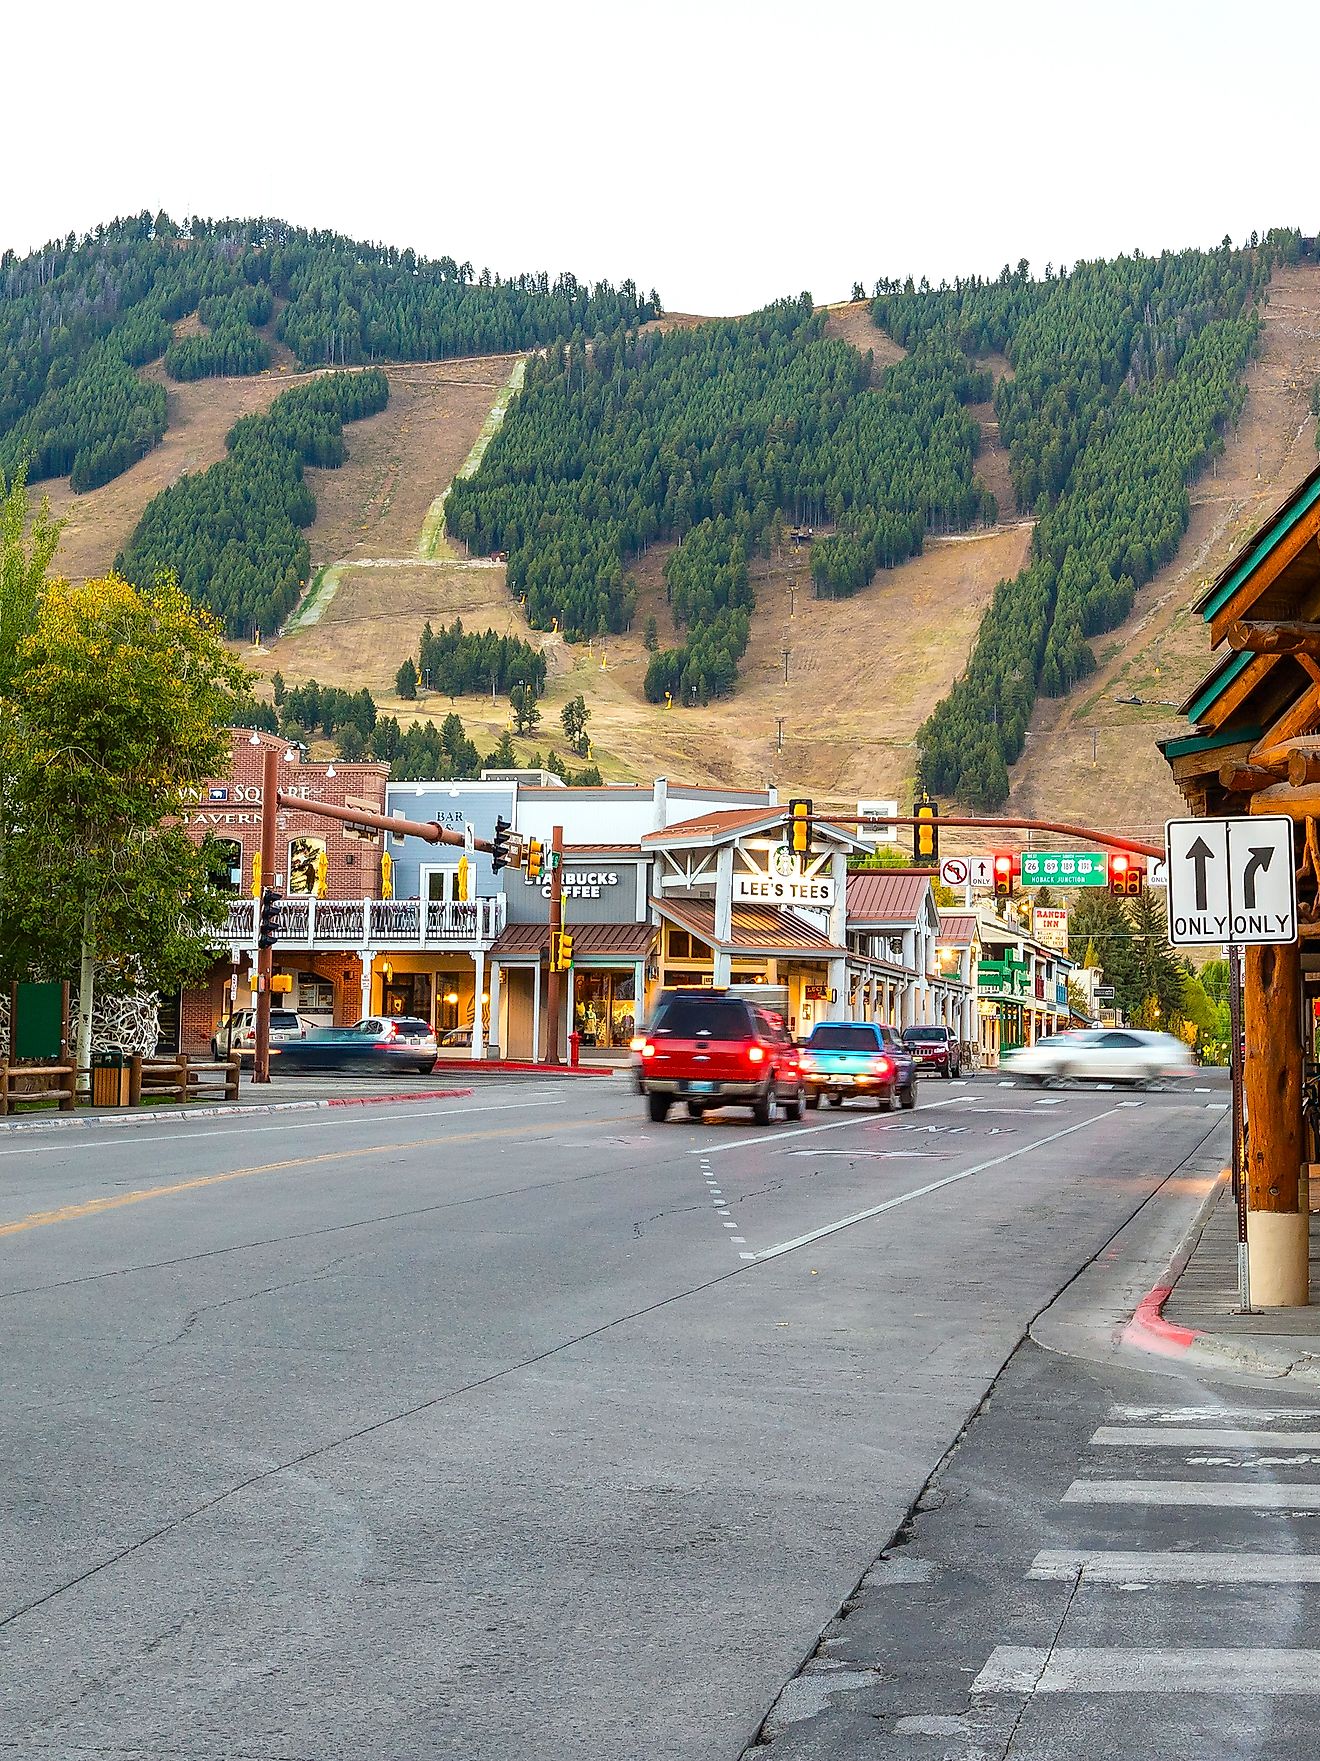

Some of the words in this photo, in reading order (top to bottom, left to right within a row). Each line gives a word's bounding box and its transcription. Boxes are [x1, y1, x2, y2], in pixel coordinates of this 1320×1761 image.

[234, 784, 310, 804] SQARE
[436, 811, 464, 822] BAR
[541, 886, 601, 898] CFFEE
[741, 882, 783, 896] LEE'S
[790, 885, 829, 898] TEES
[1175, 917, 1227, 935] ONLY
[1234, 915, 1289, 934] ONLY
